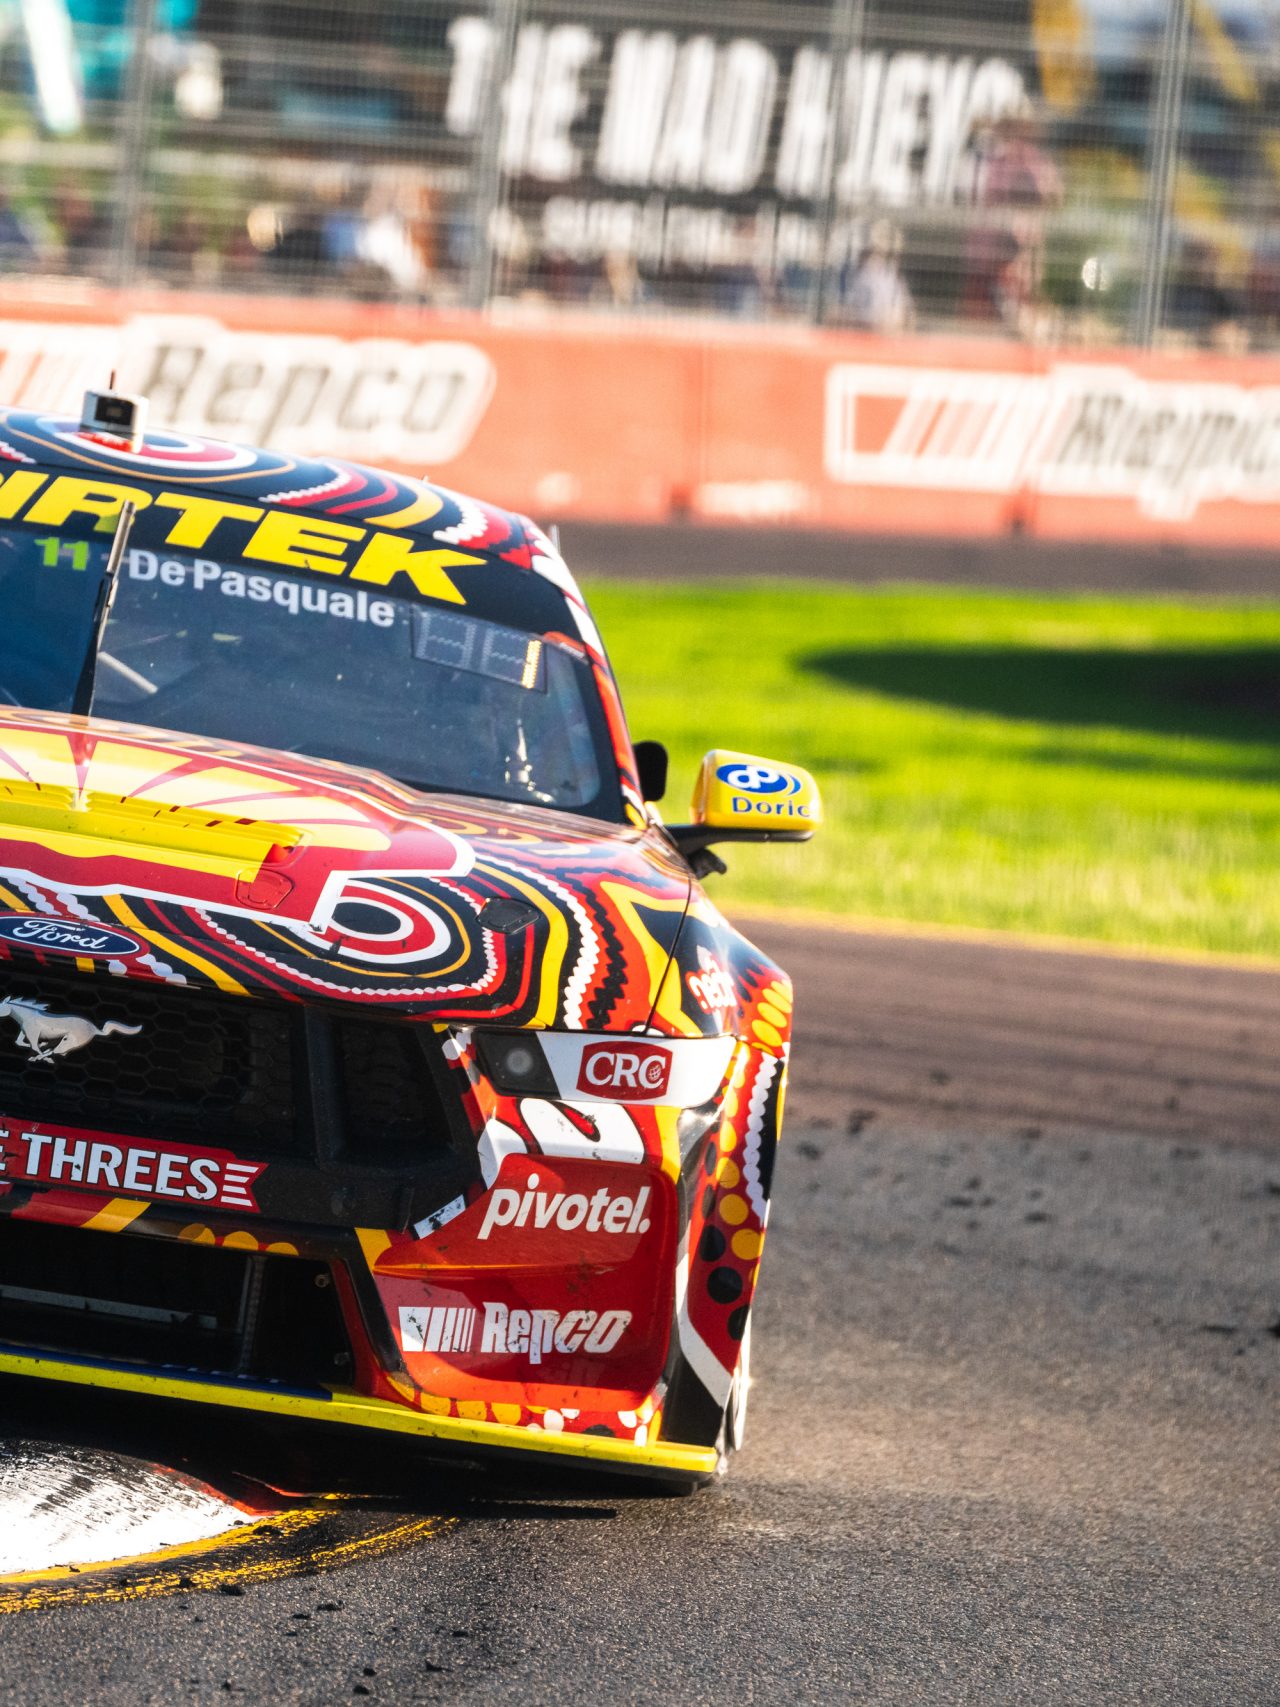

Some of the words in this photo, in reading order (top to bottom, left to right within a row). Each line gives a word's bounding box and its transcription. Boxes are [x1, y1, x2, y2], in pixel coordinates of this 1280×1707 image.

[594, 29, 780, 194] MAD
[136, 343, 466, 447] Repco
[33, 536, 89, 571] 11
[128, 548, 186, 587] De
[193, 558, 396, 627] Pasquale
[732, 796, 812, 818] Doric
[12, 918, 108, 950] Ford
[584, 1050, 666, 1090] CRC
[20, 1132, 221, 1201] THREES
[476, 1172, 652, 1240] pivotel.
[480, 1301, 633, 1365] Repco
